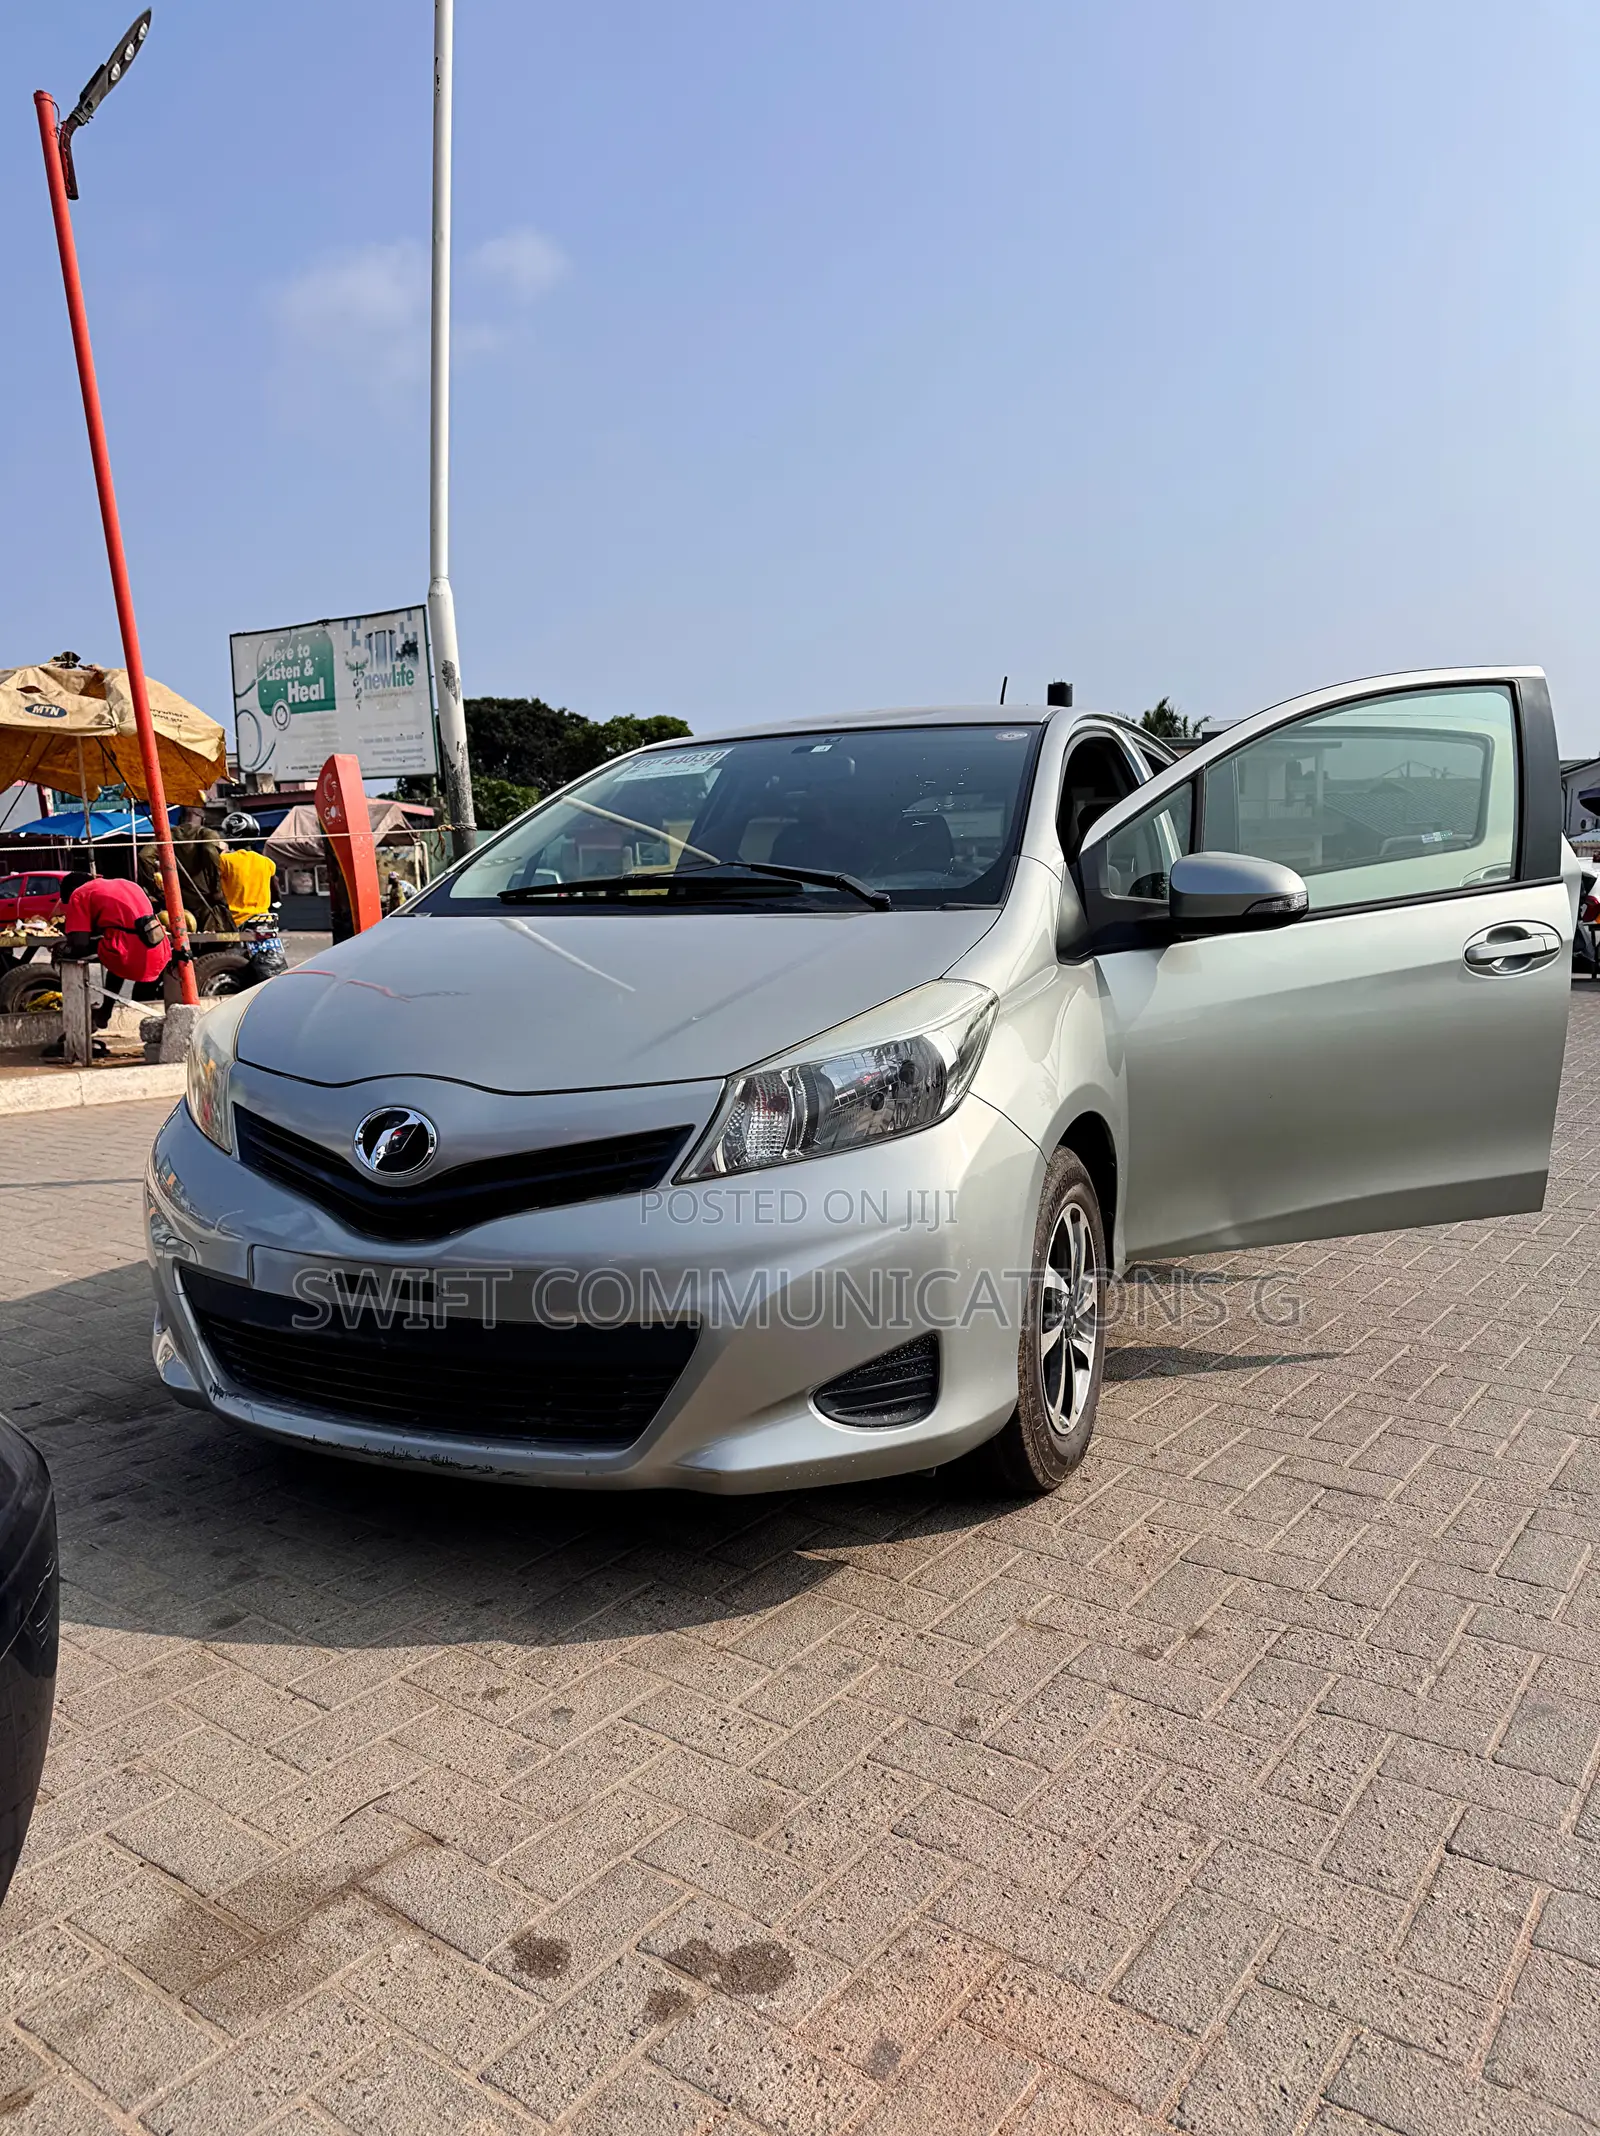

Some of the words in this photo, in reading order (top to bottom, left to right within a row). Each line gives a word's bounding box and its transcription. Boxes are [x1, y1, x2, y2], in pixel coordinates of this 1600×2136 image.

[297, 643, 310, 658] to
[266, 664, 301, 681] Listen
[304, 659, 314, 676] &
[364, 662, 415, 690] newlife
[287, 677, 325, 703] Heal
[32, 704, 60, 716] MTN
